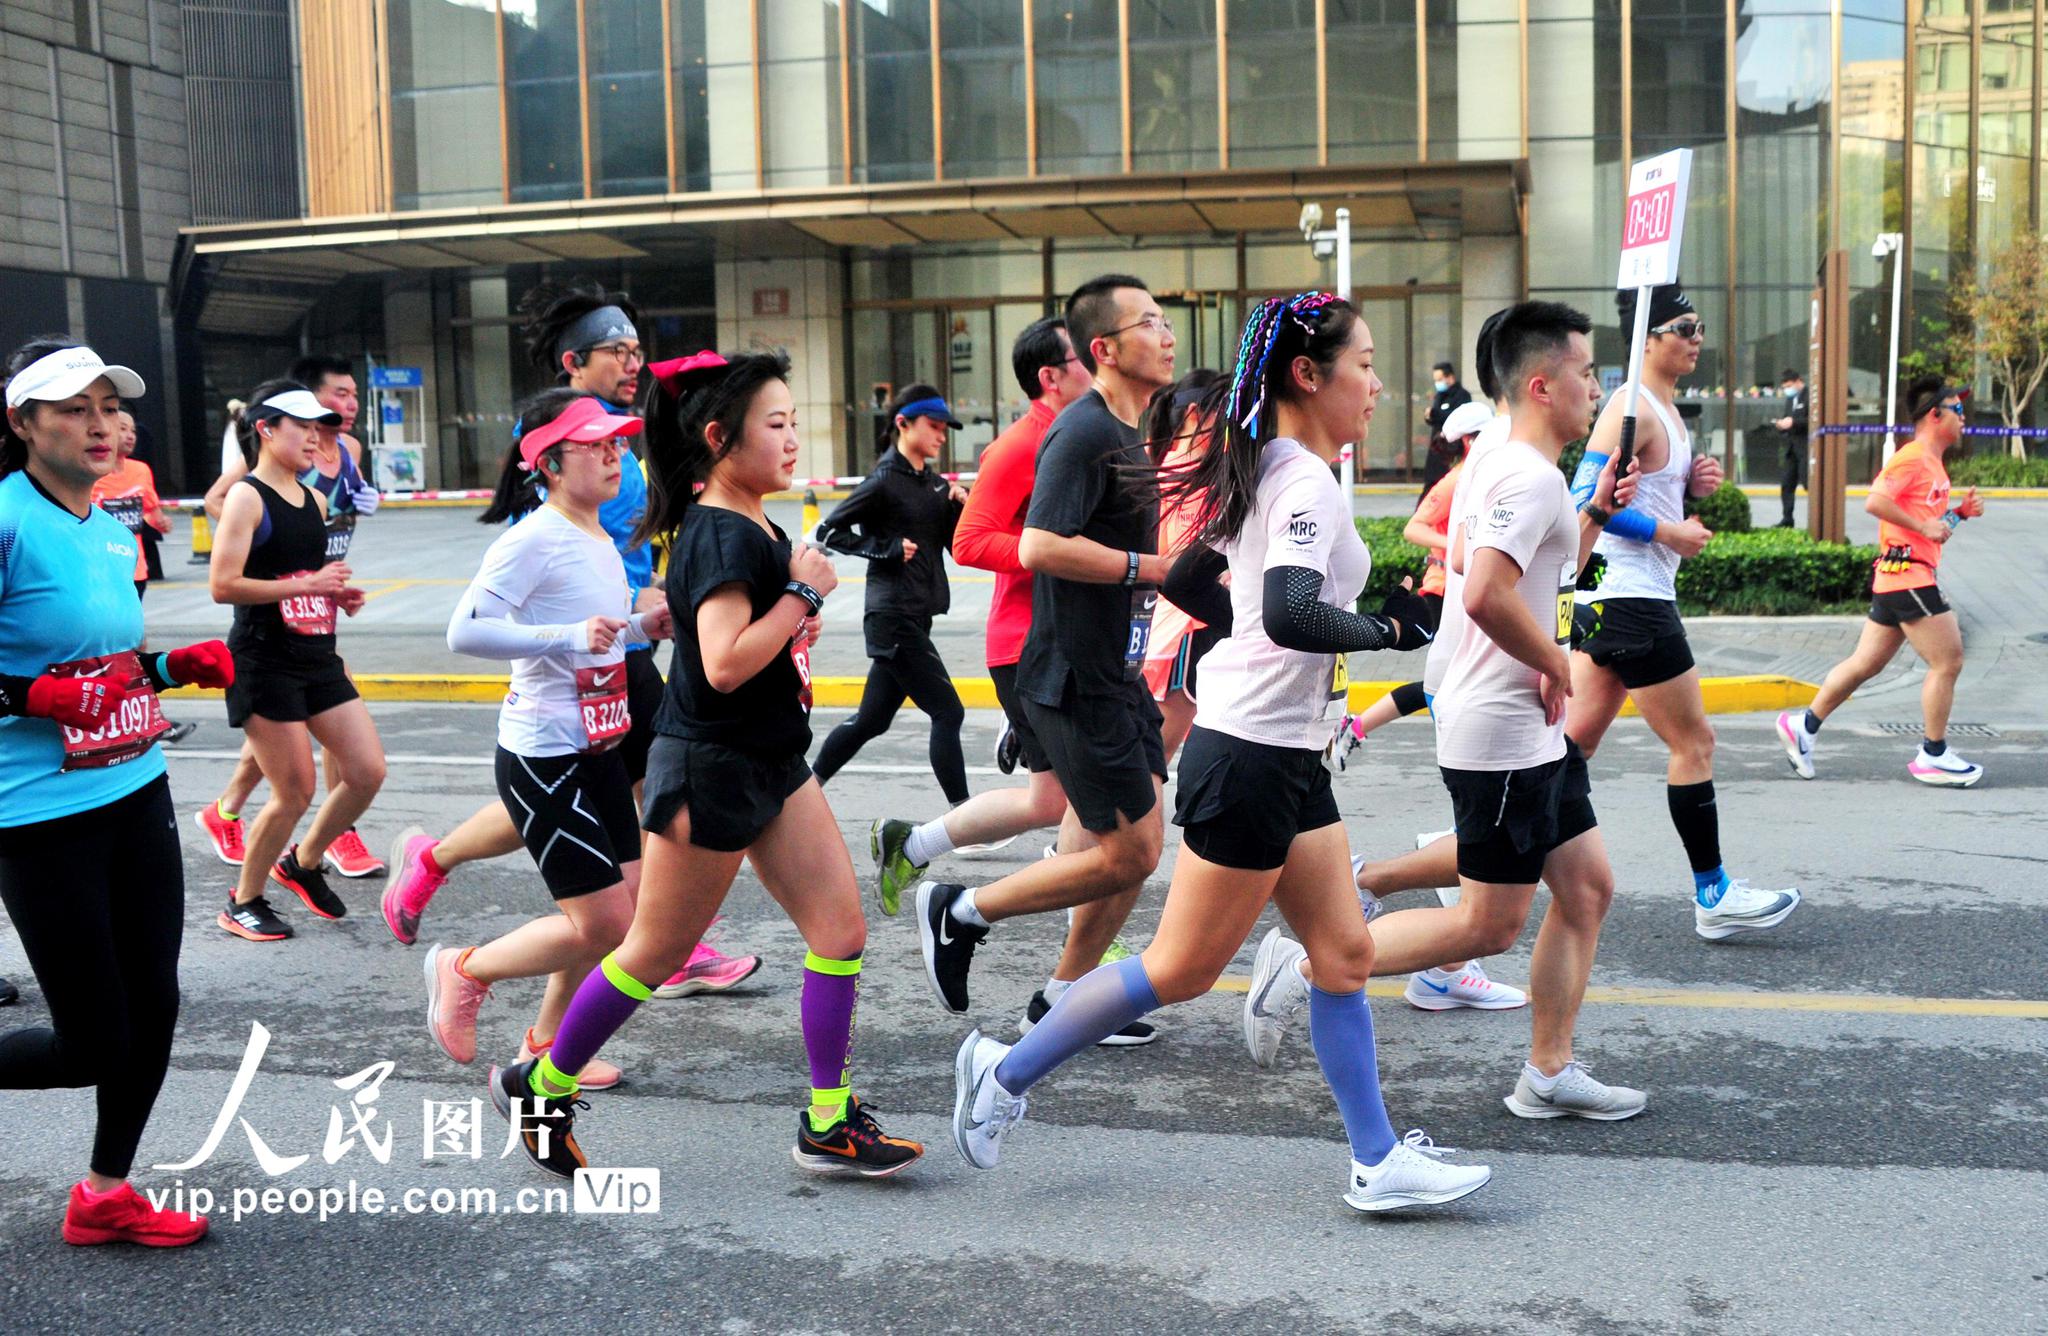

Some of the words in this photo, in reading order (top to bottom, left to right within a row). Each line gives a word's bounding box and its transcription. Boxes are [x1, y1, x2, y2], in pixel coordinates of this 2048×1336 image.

[1628, 190, 1670, 245] 04:00
[1491, 509, 1515, 523] NRC
[1289, 521, 1318, 537] NRC
